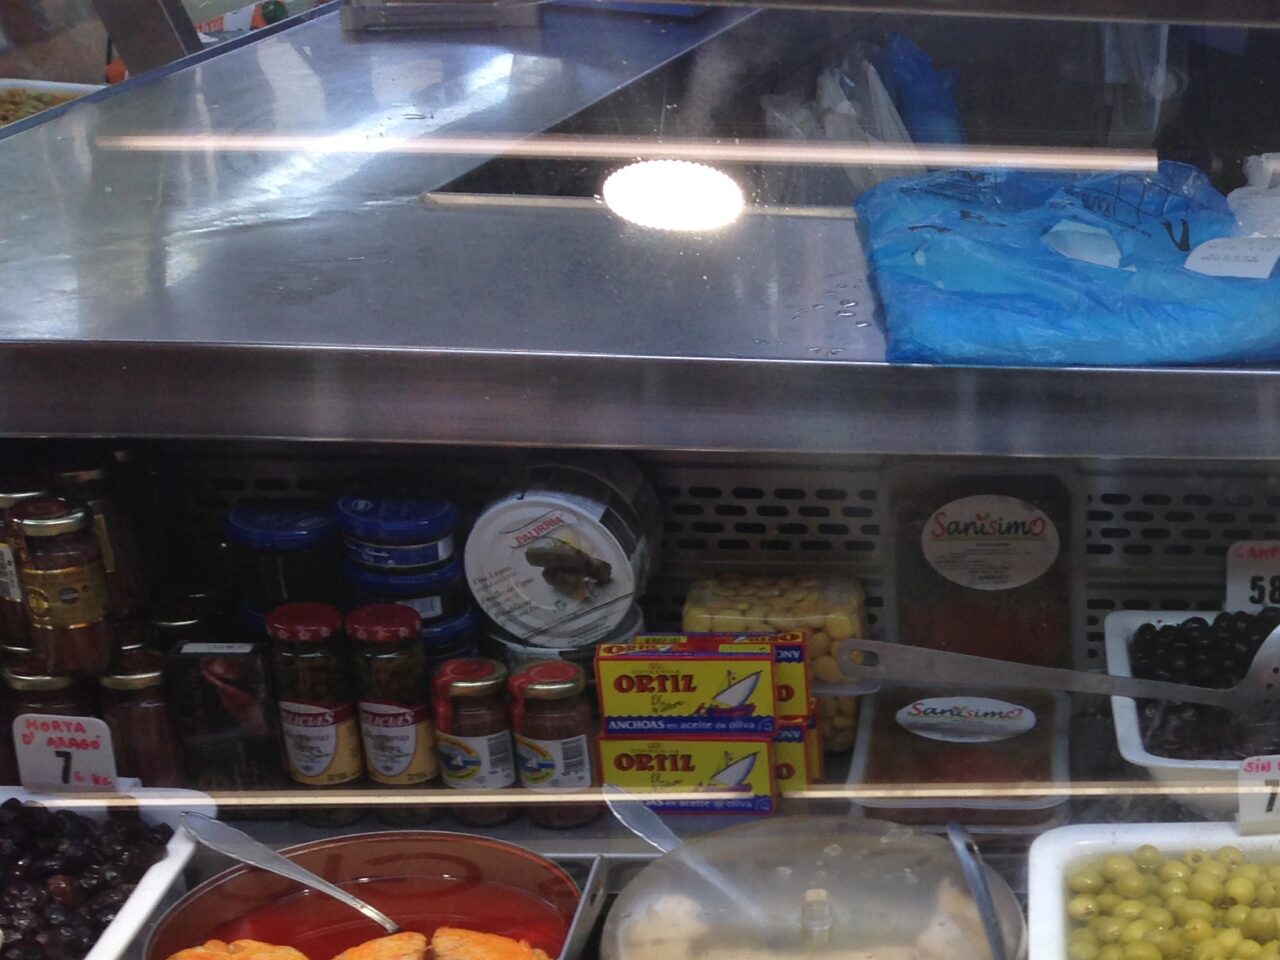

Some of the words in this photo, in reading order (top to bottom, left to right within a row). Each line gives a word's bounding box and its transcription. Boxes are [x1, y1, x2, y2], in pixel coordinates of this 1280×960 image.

[613, 674, 698, 693] ORTIZ
[608, 720, 665, 730] ANCHOAS
[680, 720, 713, 730] aceite
[728, 720, 756, 730] oliva
[54, 750, 72, 785] 7
[613, 753, 696, 772] ORTIZ
